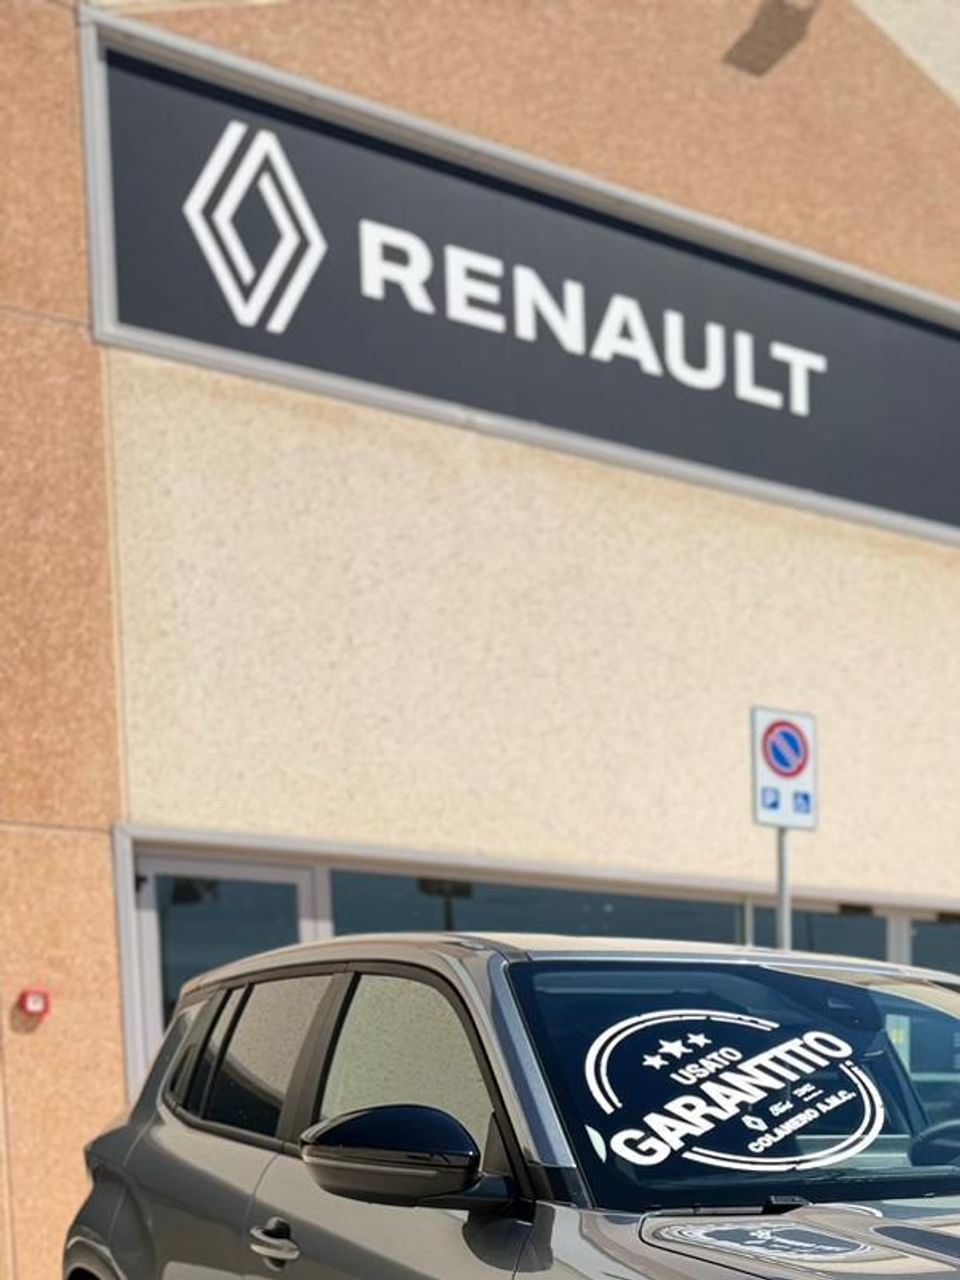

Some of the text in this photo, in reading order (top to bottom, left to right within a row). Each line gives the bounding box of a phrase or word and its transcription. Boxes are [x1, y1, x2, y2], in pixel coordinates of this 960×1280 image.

[359, 219, 827, 416] RENAULT
[610, 1031, 853, 1166] GARANTITO
[670, 1047, 743, 1085] USATO
[747, 1108, 820, 1153] COLANERO
